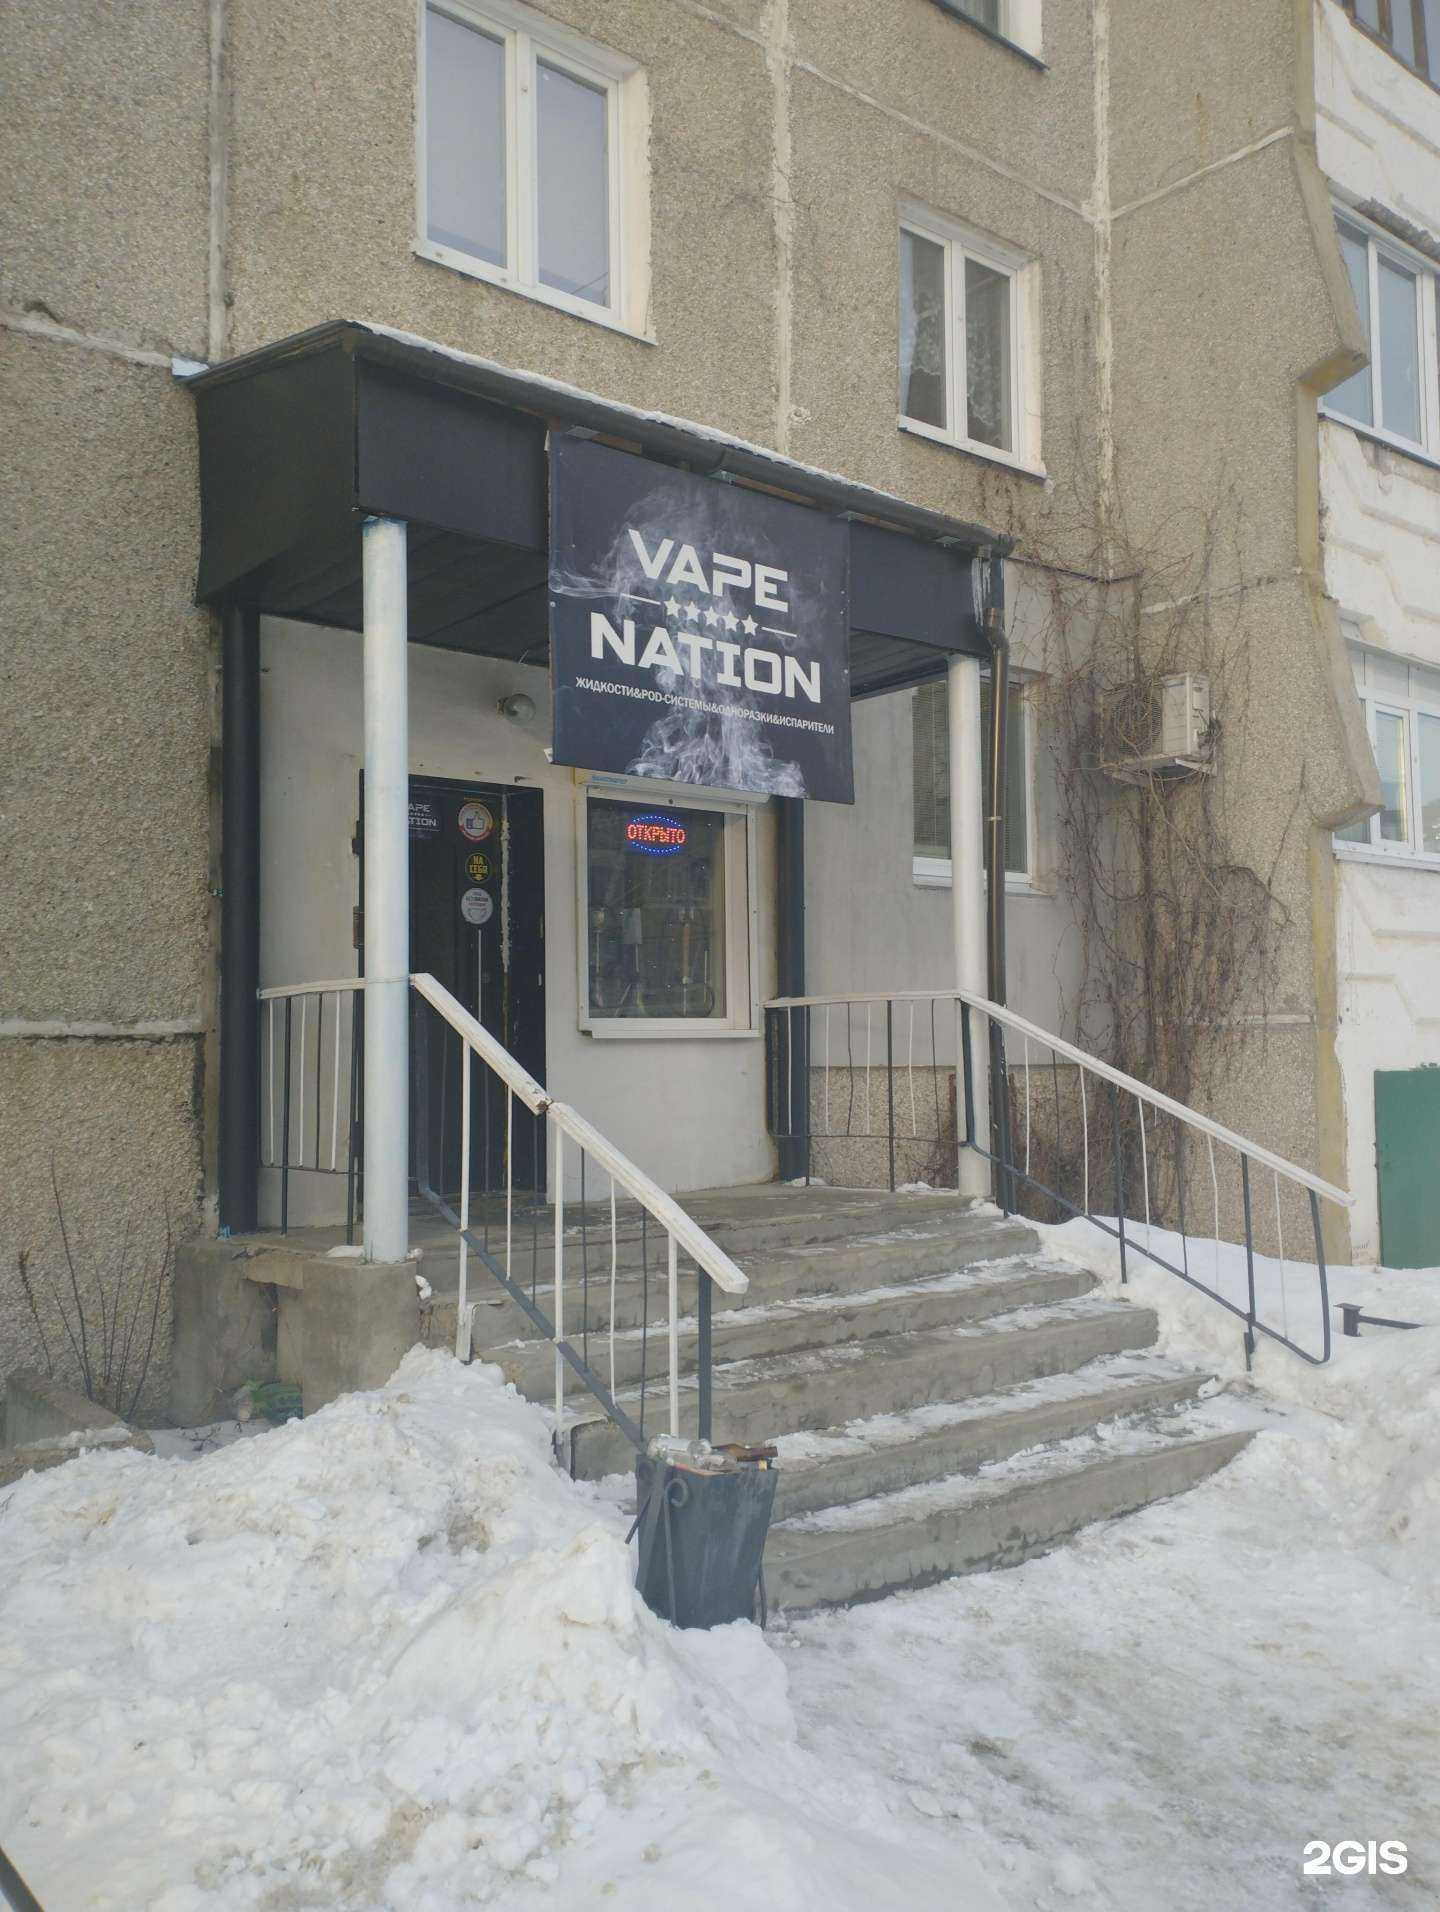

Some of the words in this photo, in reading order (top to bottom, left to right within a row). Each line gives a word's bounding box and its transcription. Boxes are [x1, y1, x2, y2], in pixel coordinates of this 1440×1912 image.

[628, 528, 788, 613] VAPE
[590, 611, 821, 704] NATION
[408, 803, 431, 813] APE
[408, 816, 437, 827] TION
[626, 824, 686, 844] ОТКРЫТО
